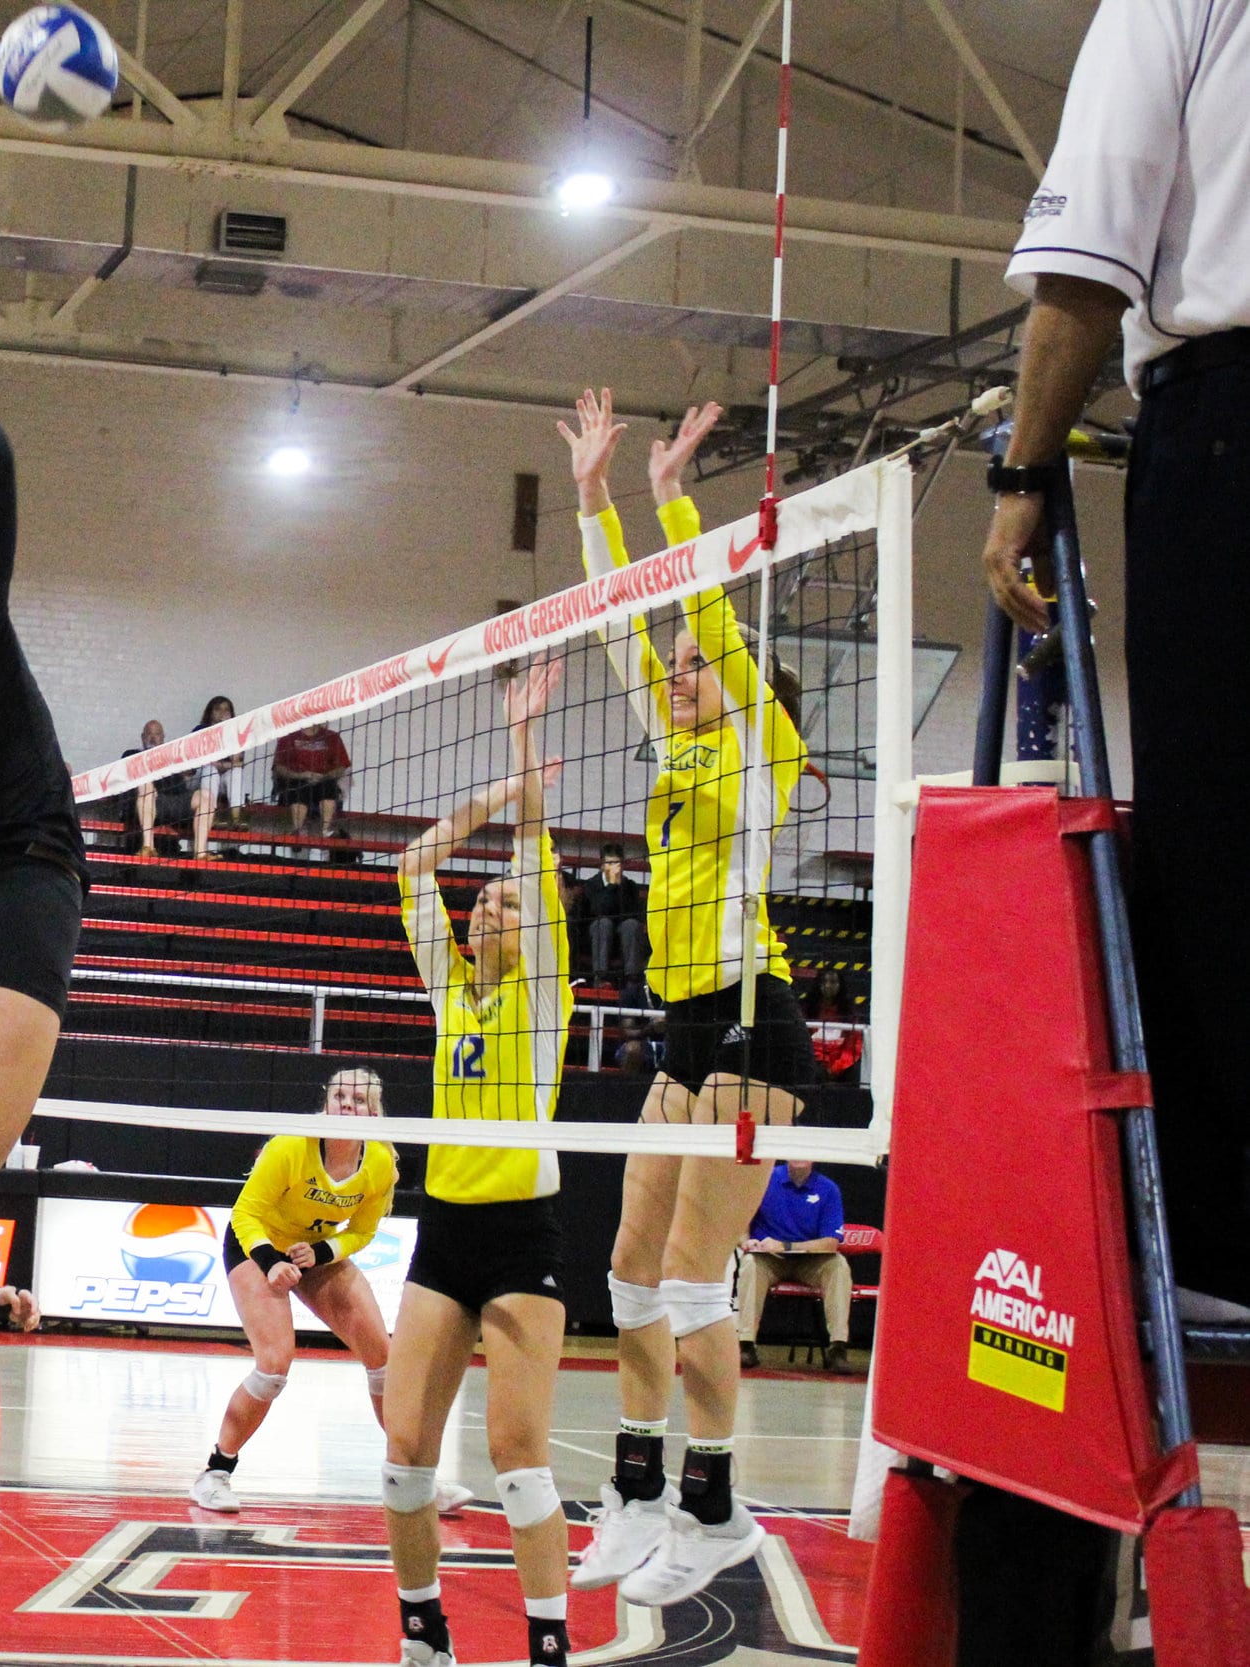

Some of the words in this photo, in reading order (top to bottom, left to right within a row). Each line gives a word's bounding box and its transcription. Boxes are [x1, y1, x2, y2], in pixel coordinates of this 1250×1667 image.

[484, 608, 528, 655] NORTH
[529, 578, 607, 639] GREENVILLE
[607, 543, 698, 607] UNIVERSITY
[661, 802, 686, 847] 7
[452, 1036, 486, 1077] 12
[70, 1276, 218, 1316] PEPSI
[970, 1287, 1075, 1347] AMERICAN
[982, 1330, 1055, 1366] WARNING
